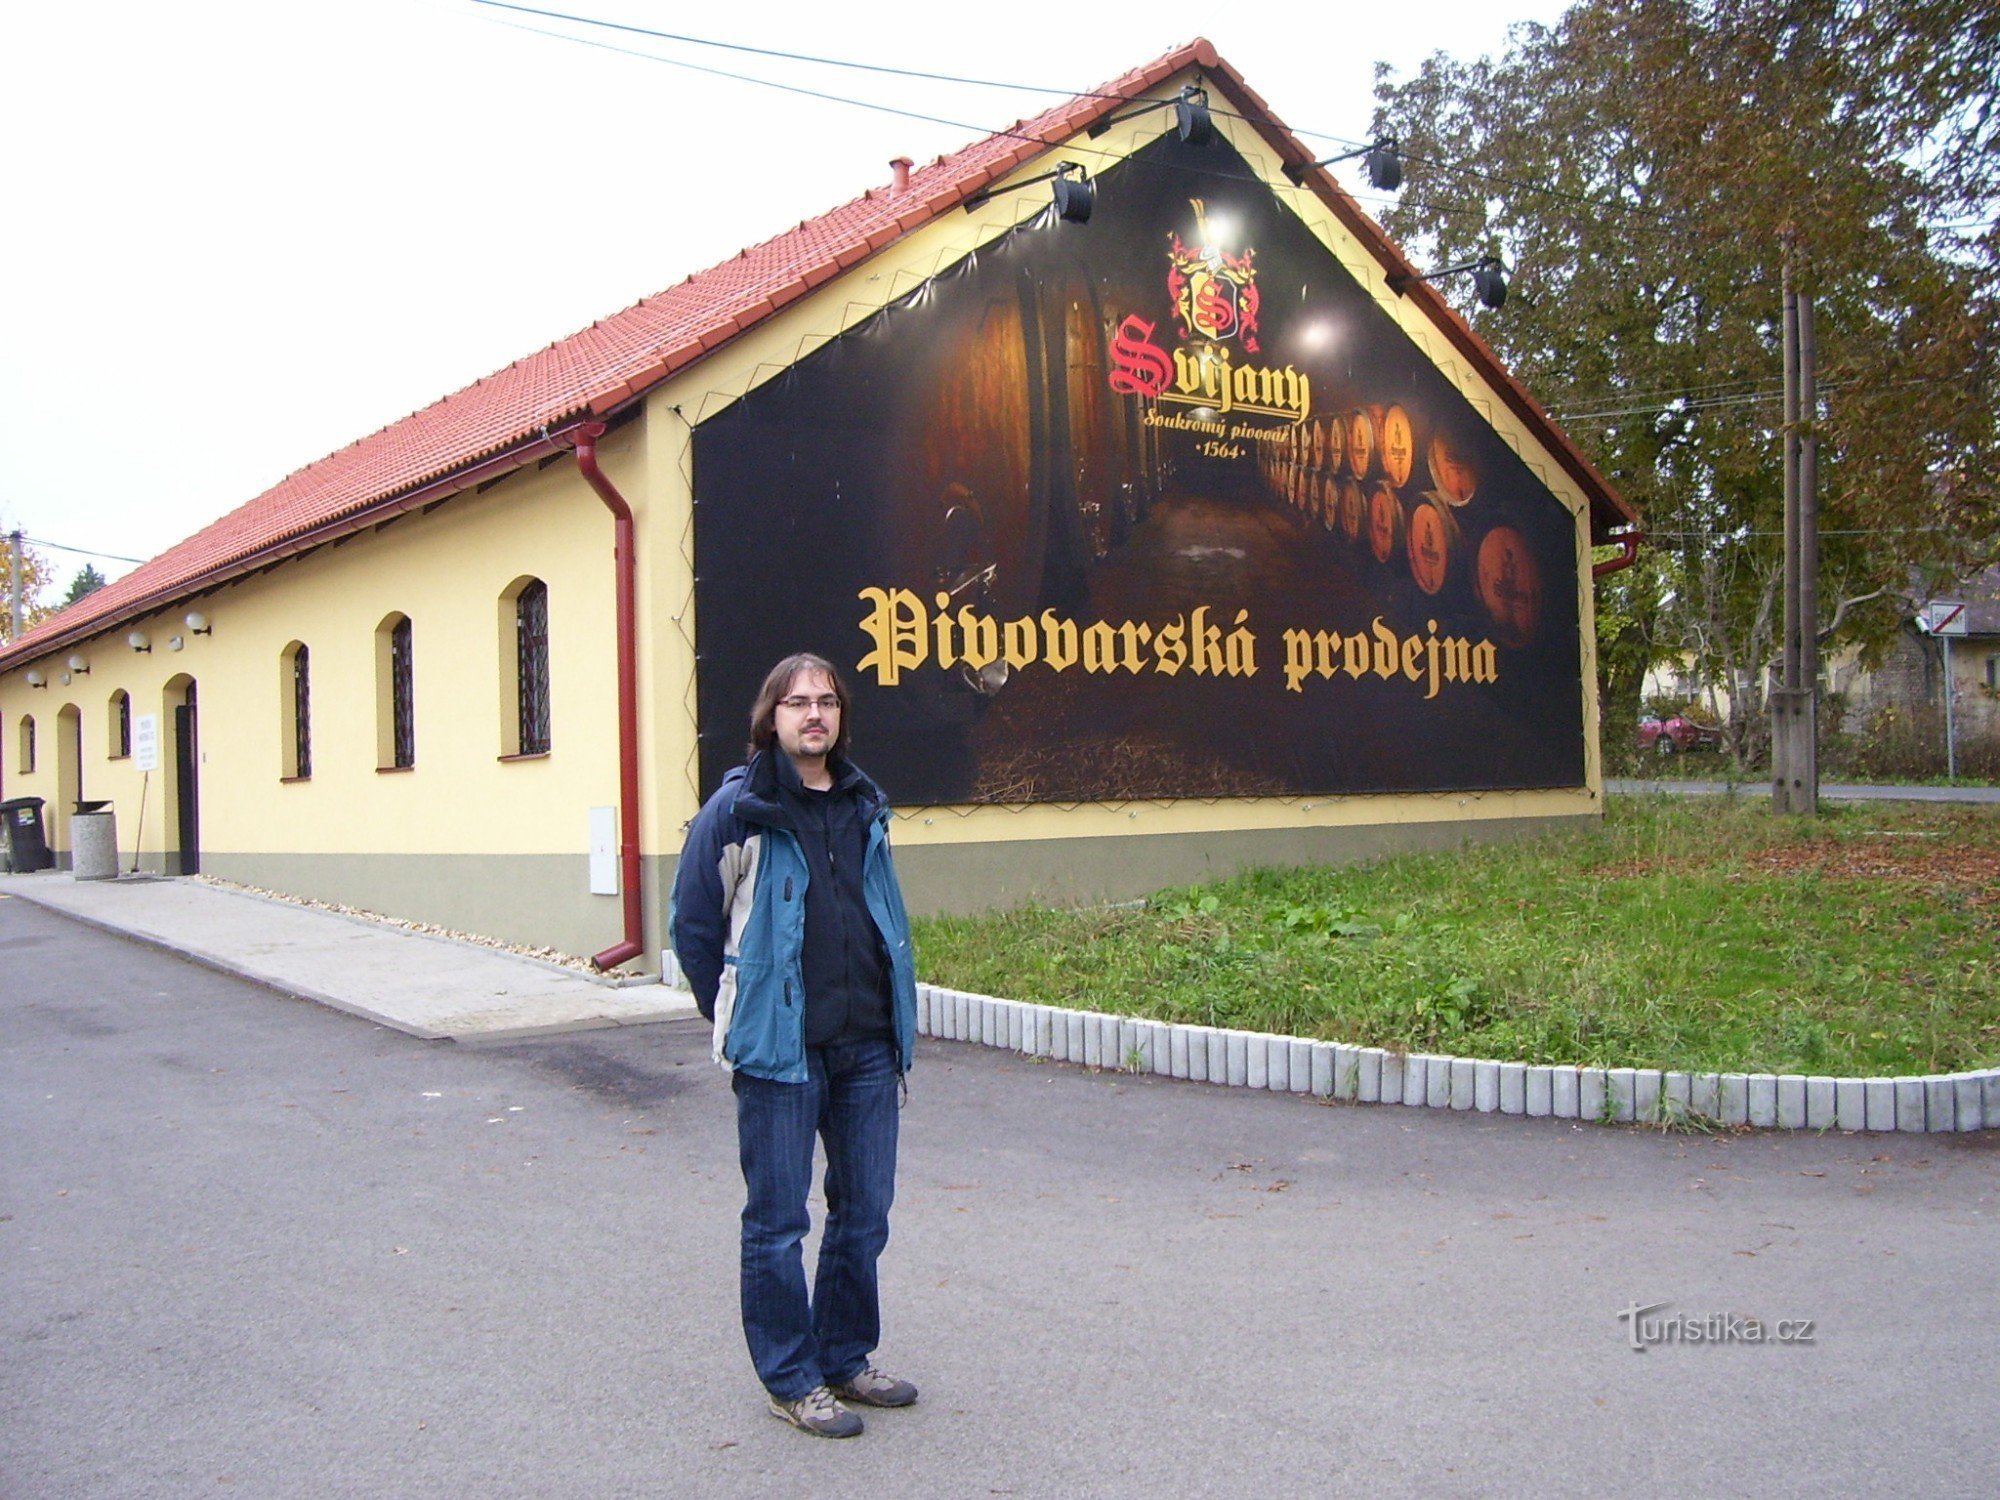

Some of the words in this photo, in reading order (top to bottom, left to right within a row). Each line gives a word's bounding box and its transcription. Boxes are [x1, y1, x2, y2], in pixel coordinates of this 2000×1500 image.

[1108, 313, 1310, 426] Svijany
[1143, 408, 1226, 438] Soukromý
[855, 586, 1260, 687] Pivovarská
[1282, 615, 1499, 700] prodejna
